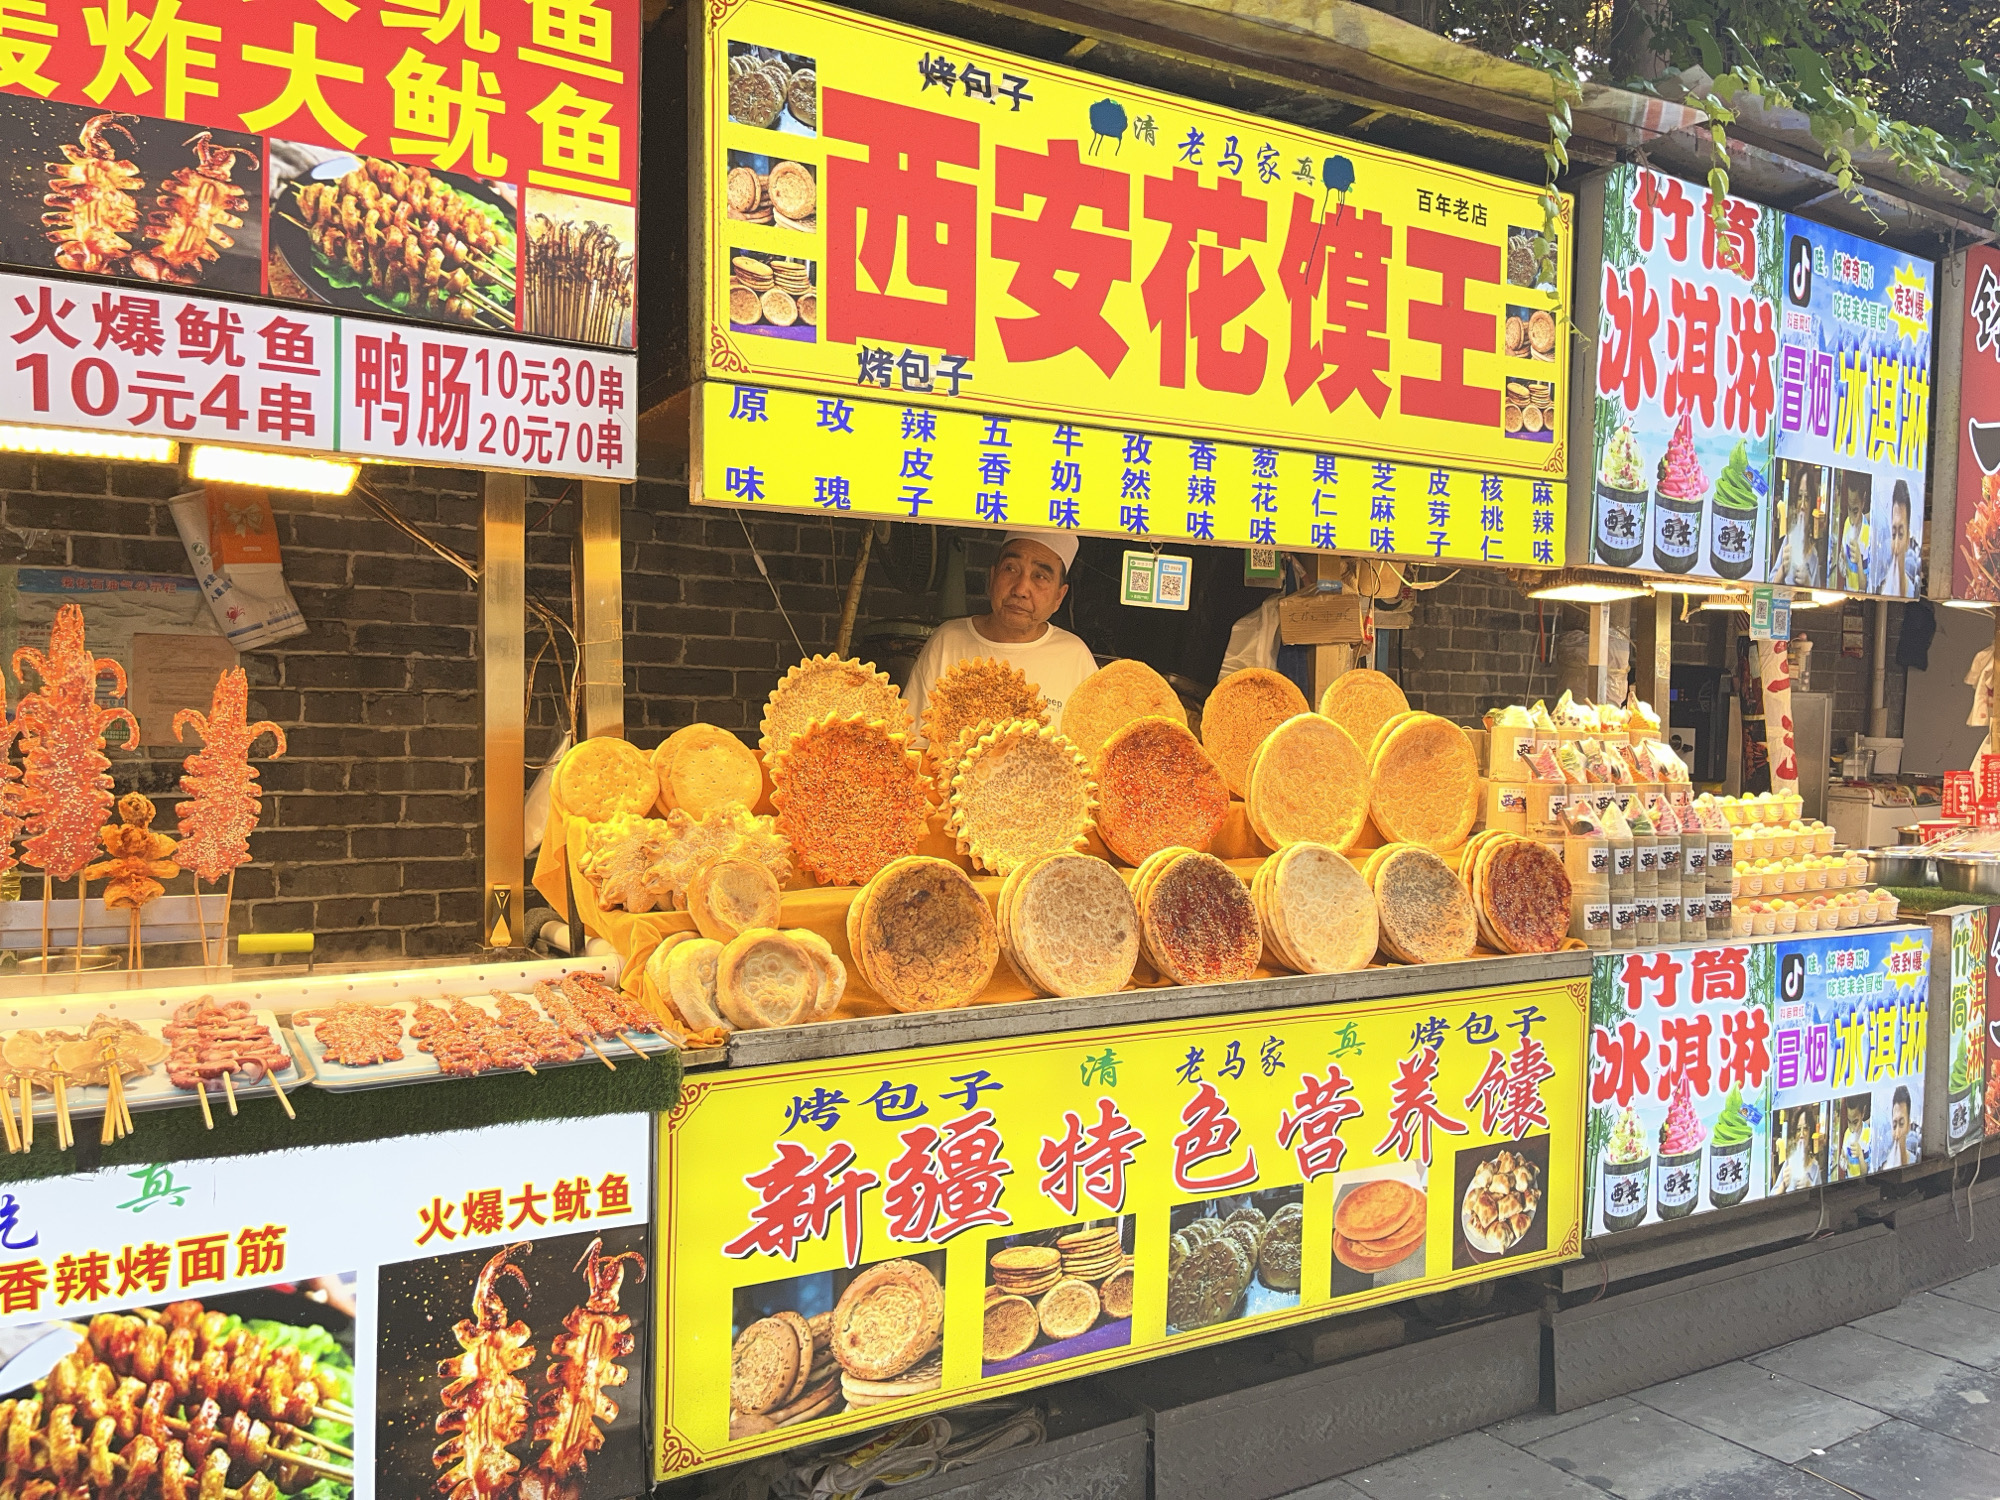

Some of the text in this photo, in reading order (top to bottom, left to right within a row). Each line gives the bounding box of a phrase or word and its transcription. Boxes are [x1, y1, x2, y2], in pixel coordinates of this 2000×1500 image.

[918, 52, 1033, 111] 烤包子
[1134, 114, 1315, 186] 清 老马家 真
[1416, 188, 1488, 227] 百年老店
[1632, 171, 1759, 281] 竹筒
[822, 86, 1501, 428] 西安花馍王
[1894, 285, 1925, 322] 凉到爆
[11, 286, 320, 377] 火爆鱿鱼
[857, 345, 973, 396] 烤包子
[1600, 266, 1776, 437] 冰淇淋
[16, 352, 320, 441] 10元4串
[355, 332, 471, 451] 鸭肠
[475, 348, 624, 416] 10元30串
[478, 412, 623, 469] 20元70串
[725, 385, 768, 501] 原味
[814, 399, 854, 510] 玫瑰
[897, 408, 937, 516] 辣皮子
[976, 416, 1012, 523] 五香味
[1048, 425, 1084, 529] 牛奶味
[1120, 434, 1152, 534] 孜然味
[1186, 441, 1217, 540] 香辣味
[1249, 448, 1279, 545] 葱花味
[1311, 455, 1338, 549] 果仁味
[1370, 462, 1397, 554] 芝麻味
[1426, 469, 1451, 557] 皮芽子
[1480, 474, 1505, 562] 核桃仁
[1531, 480, 1554, 565] 麻辣味
[1621, 947, 1749, 1010] 竹筒
[1891, 951, 1922, 973] 凉到爆
[1952, 927, 1969, 1034] 竹筒
[1966, 910, 1987, 1083] 冰淇淋
[779, 1005, 1547, 1137] 烤包子 清 老马家 真 烤包子
[1592, 1008, 1770, 1108] 冰淇淋
[116, 1162, 192, 1213] 真
[724, 1036, 1553, 1268] 新疆特色营养馕
[417, 1173, 632, 1244] 火爆大鱿鱼
[0, 1225, 288, 1314] 香辣烤面筋
